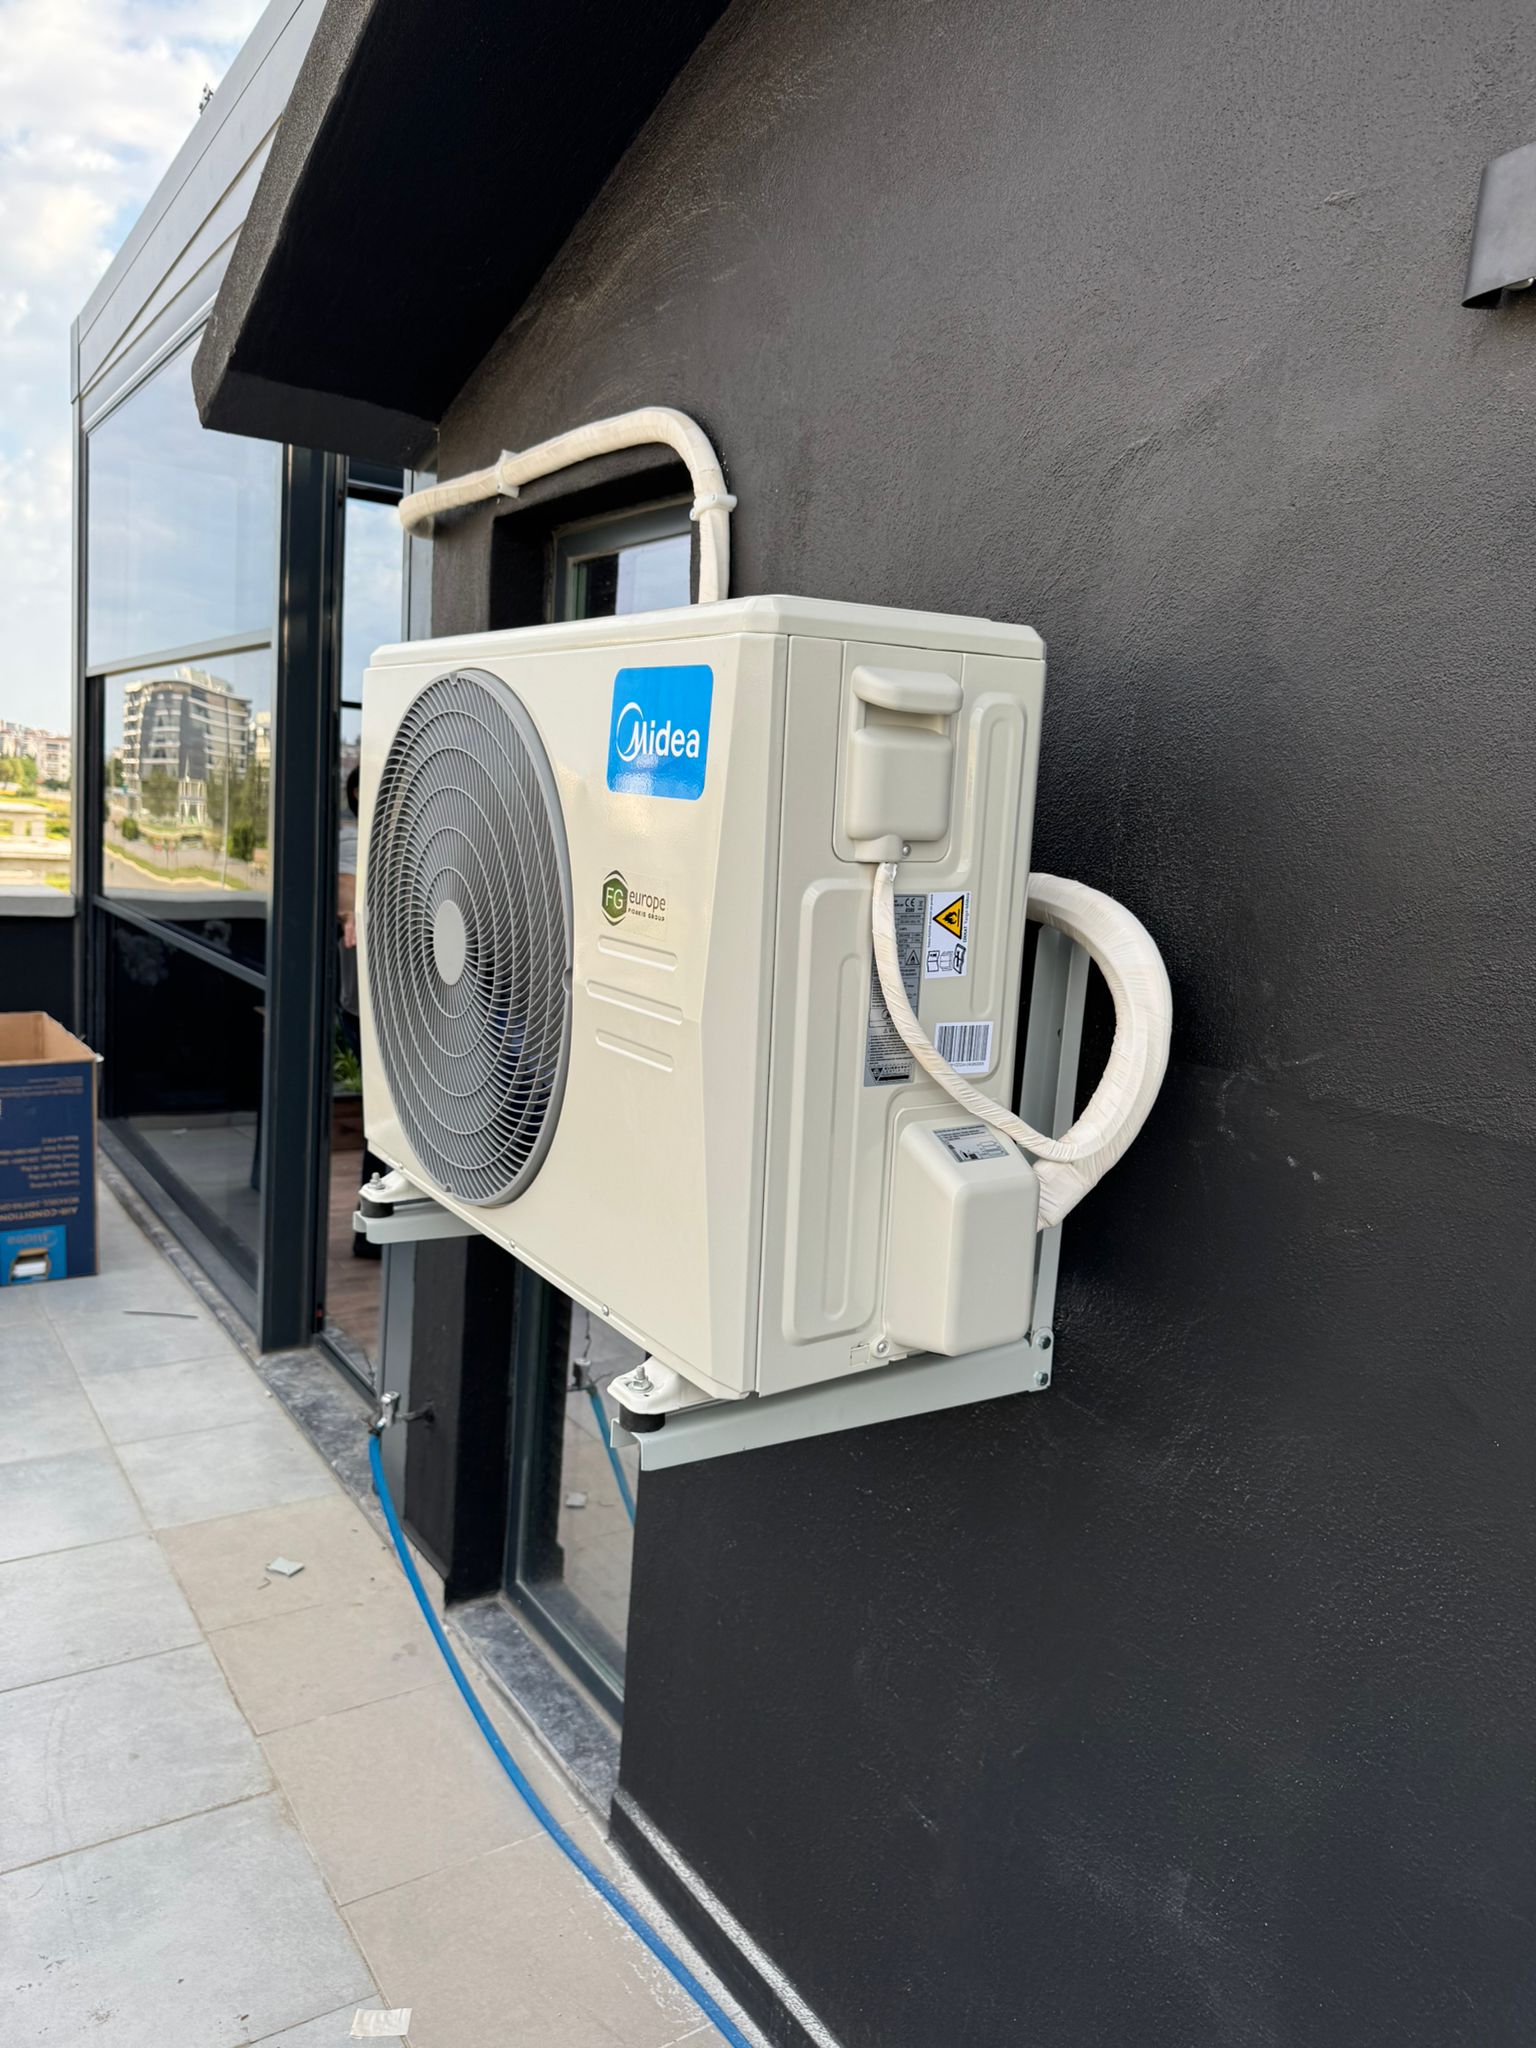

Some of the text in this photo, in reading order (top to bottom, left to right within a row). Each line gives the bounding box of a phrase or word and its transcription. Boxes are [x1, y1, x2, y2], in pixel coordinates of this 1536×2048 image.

[616, 702, 700, 762] Midea
[605, 886, 666, 913] FG europe
